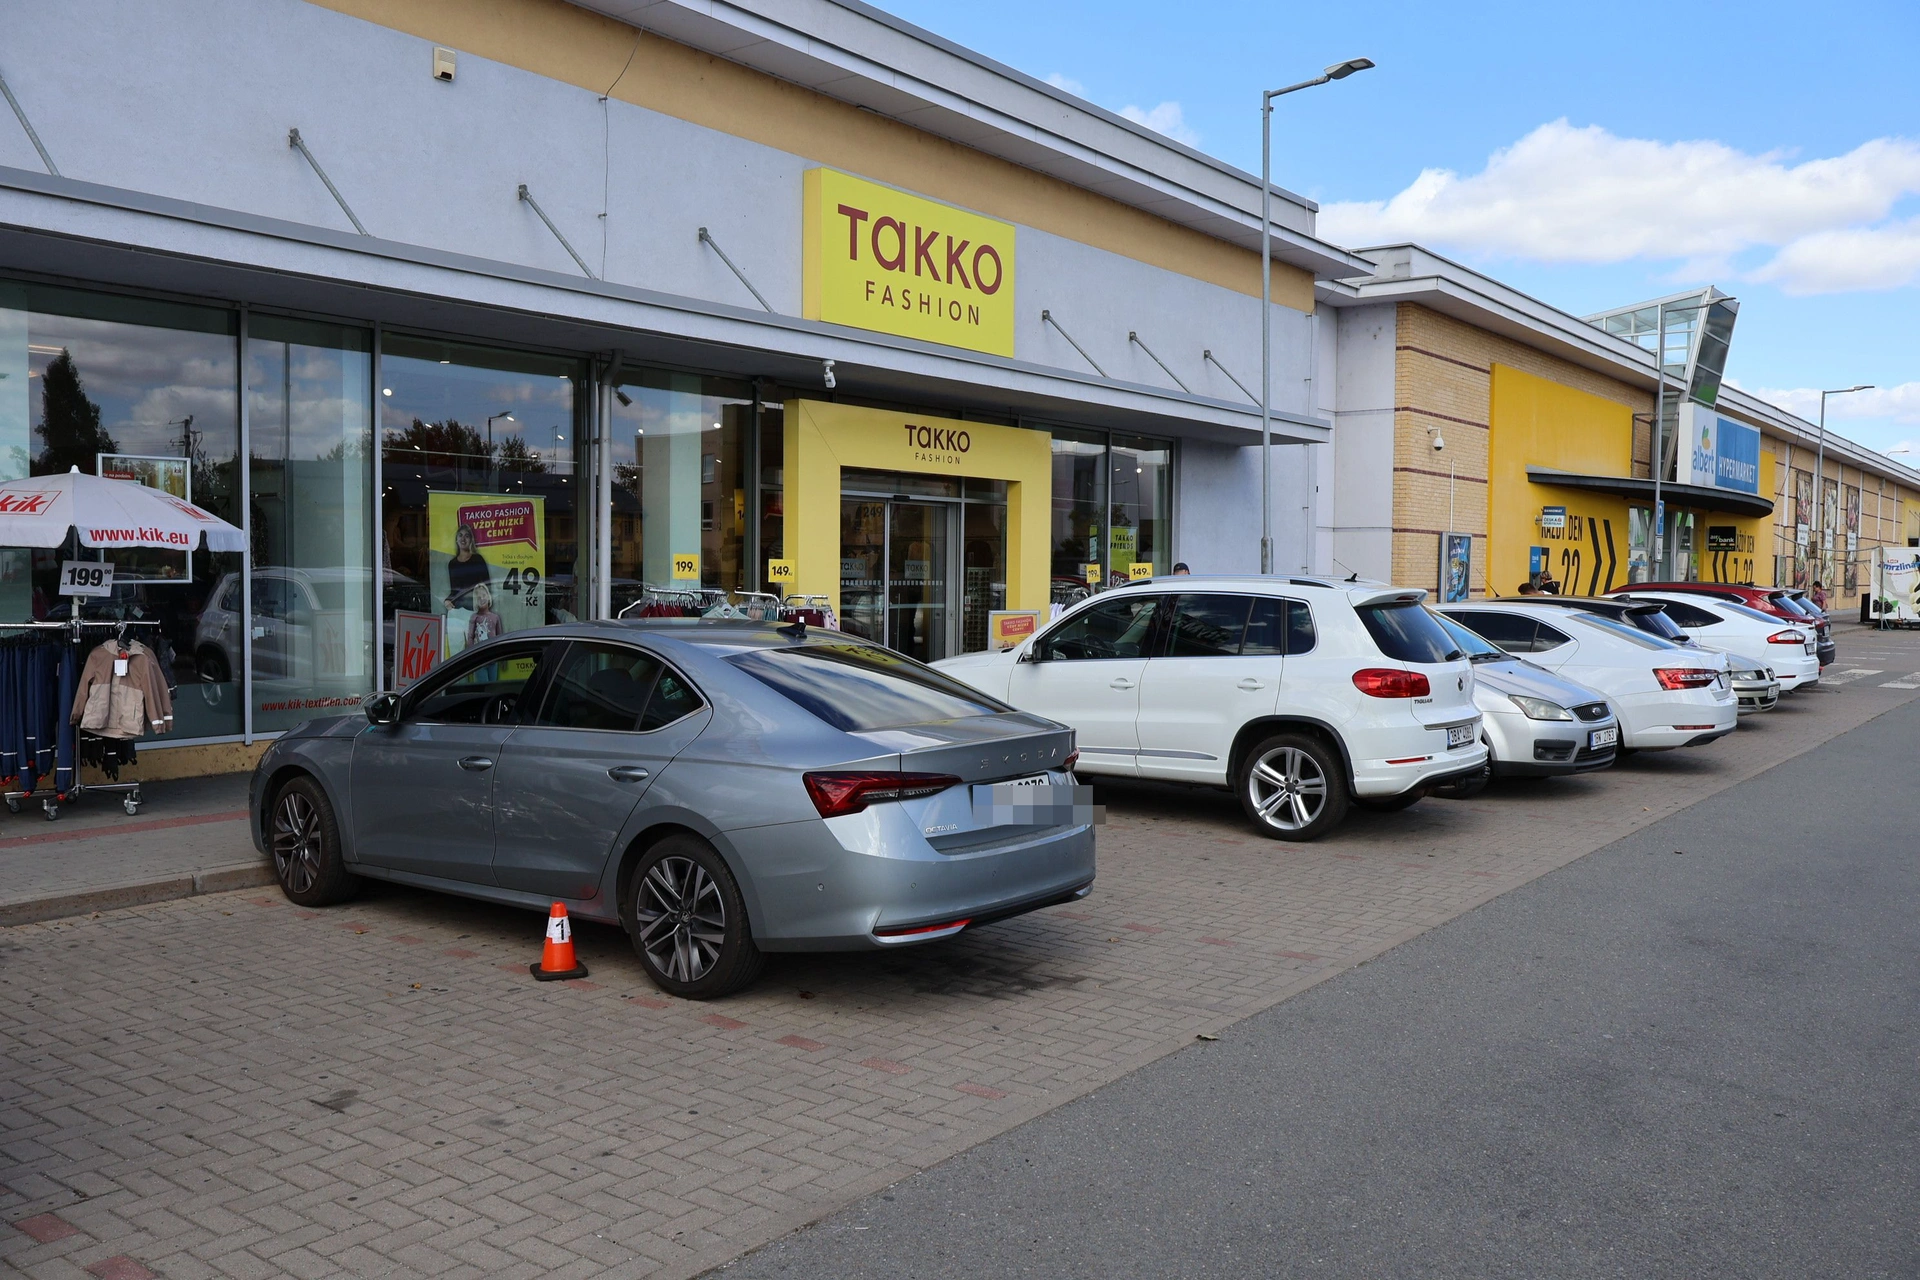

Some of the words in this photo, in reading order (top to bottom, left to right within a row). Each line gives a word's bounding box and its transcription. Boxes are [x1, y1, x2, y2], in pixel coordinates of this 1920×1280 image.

[865, 280, 979, 326] FASHION
[915, 452, 960, 464] FASHION
[1692, 445, 1714, 474] albert
[1718, 455, 1756, 484] HYPERMARKET
[465, 510, 492, 520] TAKKO
[494, 506, 530, 518] FASHION
[864, 506, 883, 518] 249
[473, 518, 497, 530] VŽDY
[499, 515, 524, 527] NÍZKÉ
[1568, 514, 1583, 542] DEN
[89, 527, 189, 545] www.kik.eu
[486, 527, 513, 538] CENY!
[675, 561, 693, 572] 199
[771, 565, 789, 576] 149
[1131, 567, 1148, 576] 149
[503, 566, 540, 595] 49
[525, 596, 538, 607] Kč
[261, 696, 362, 711] www.kik-textilien.com
[925, 823, 958, 834] OCTAVIA
[555, 918, 565, 941] 1
